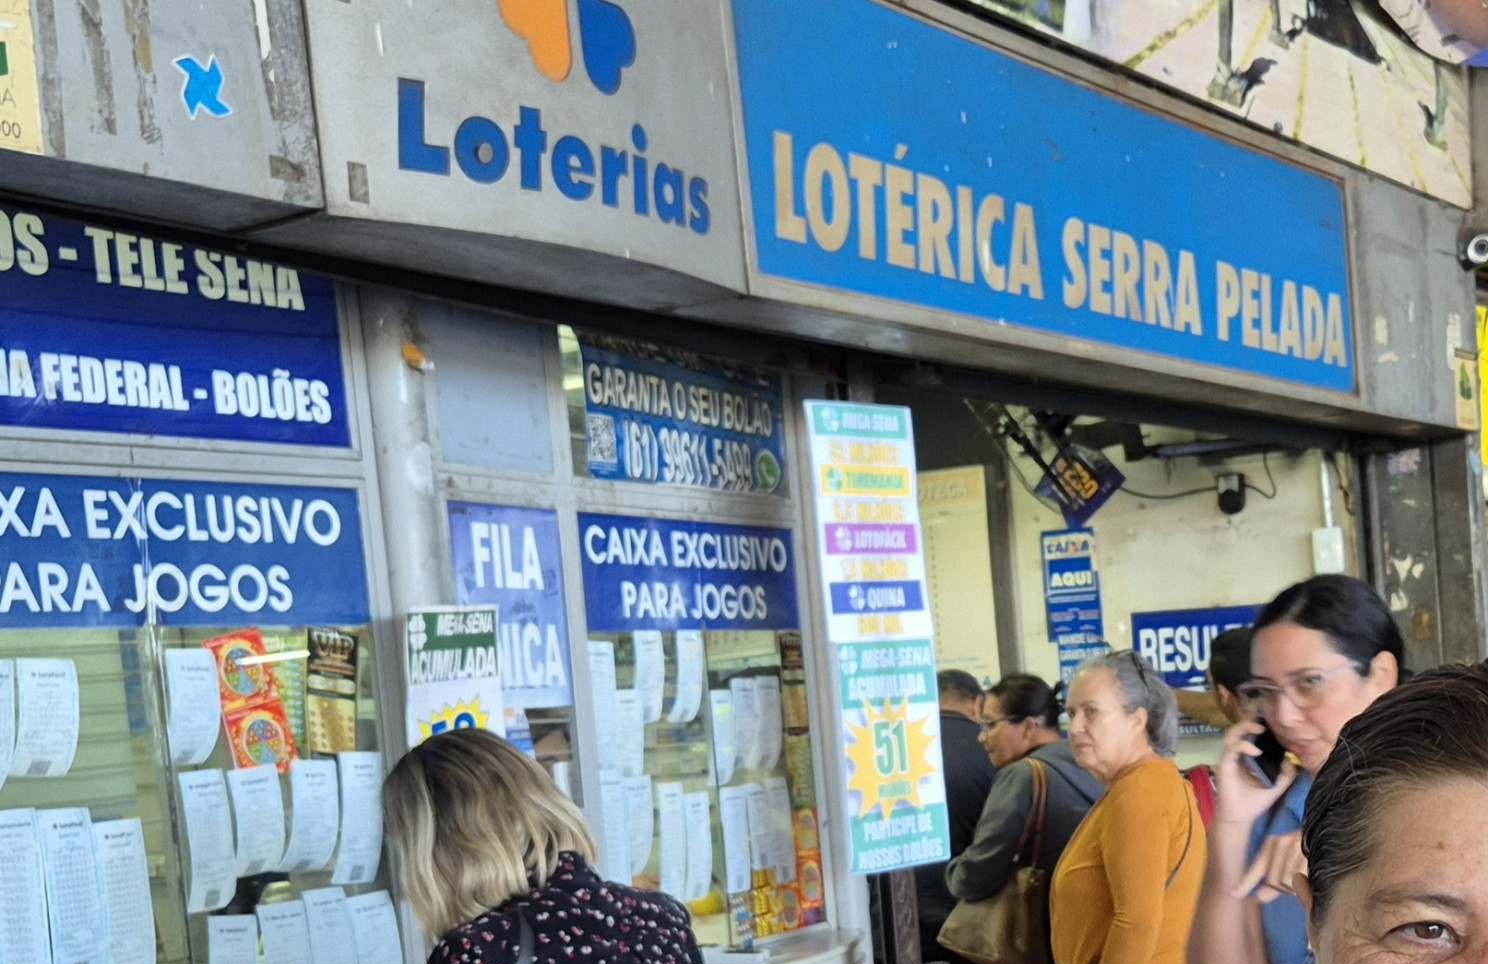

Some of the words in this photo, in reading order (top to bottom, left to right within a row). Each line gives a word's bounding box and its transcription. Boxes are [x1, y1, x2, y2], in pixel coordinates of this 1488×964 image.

[398, 76, 711, 236] Loterias
[84, 225, 188, 294] TELE
[194, 249, 305, 311] SENA
[773, 130, 1045, 299] LOTÉRICA
[1061, 217, 1204, 337] SERRA
[1215, 259, 1348, 368] PELADA
[40, 351, 190, 411] FEDERAL
[211, 367, 332, 424] BOLÕES
[586, 362, 672, 418] GARANTA
[673, 381, 687, 421] O
[689, 386, 721, 429] SEU
[723, 391, 773, 437] BOLÃO
[842, 411, 900, 434] MEGA-SENA
[623, 418, 658, 481] (61)
[83, 489, 341, 546] EXCLUSIVO
[854, 526, 906, 551] LOTOFÁCIL
[470, 521, 545, 591] FILA
[584, 524, 668, 567] CAIXA
[670, 530, 787, 573] EXCLUSIVO
[124, 562, 294, 612] JOGOS
[620, 580, 687, 620] PARA
[690, 582, 768, 621] JOGOS
[867, 586, 906, 611] QUINA
[1051, 570, 1092, 588] AQUI
[409, 647, 499, 684] ACUMULADA
[860, 645, 931, 669] MEGA-SENA
[848, 672, 926, 699] ACUMULADA
[873, 720, 907, 776] 51
[863, 815, 917, 842] PARTICIPE
[918, 811, 933, 833] DE
[858, 843, 901, 870] NOSSOS
[902, 836, 943, 865] BOLÕES
